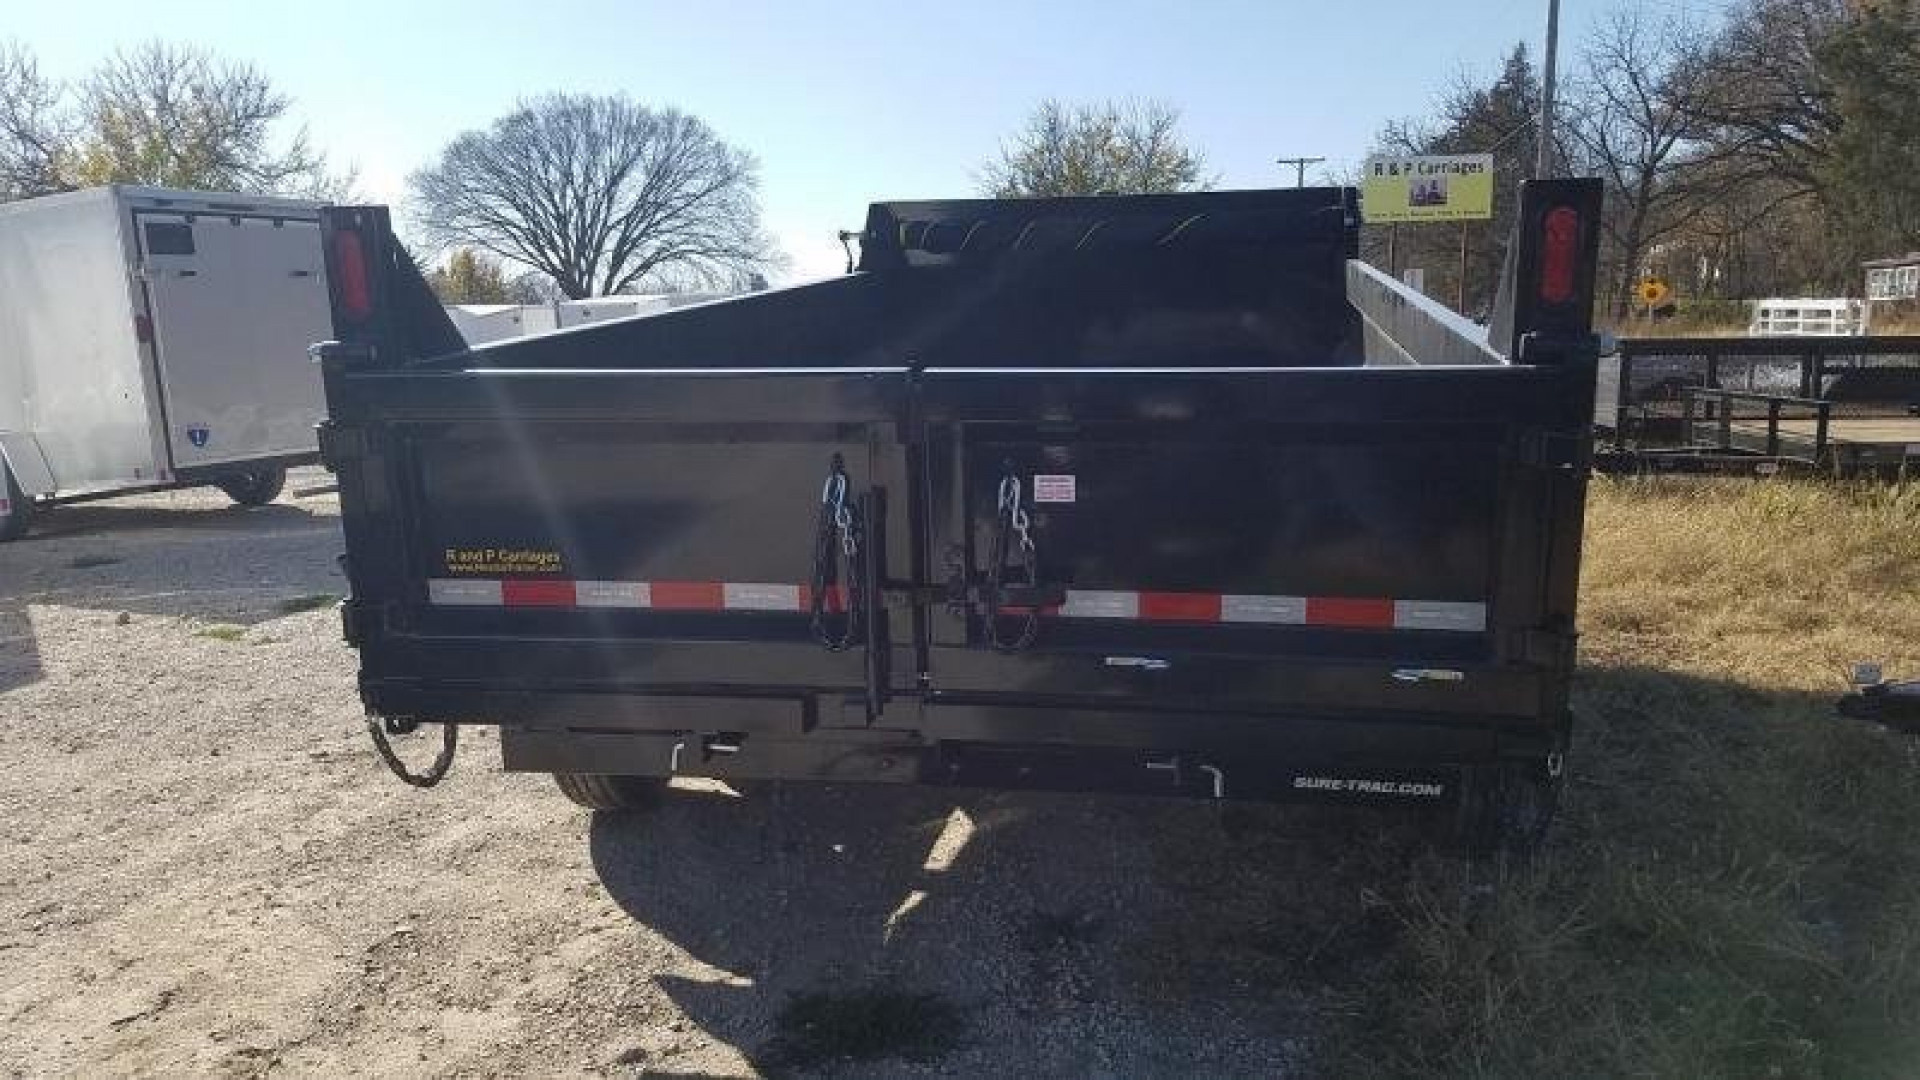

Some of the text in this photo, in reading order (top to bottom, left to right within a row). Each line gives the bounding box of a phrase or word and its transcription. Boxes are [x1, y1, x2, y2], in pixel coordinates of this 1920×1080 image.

[1375, 161, 1484, 176] R & P Carriages
[445, 549, 560, 565] R and P Carriages
